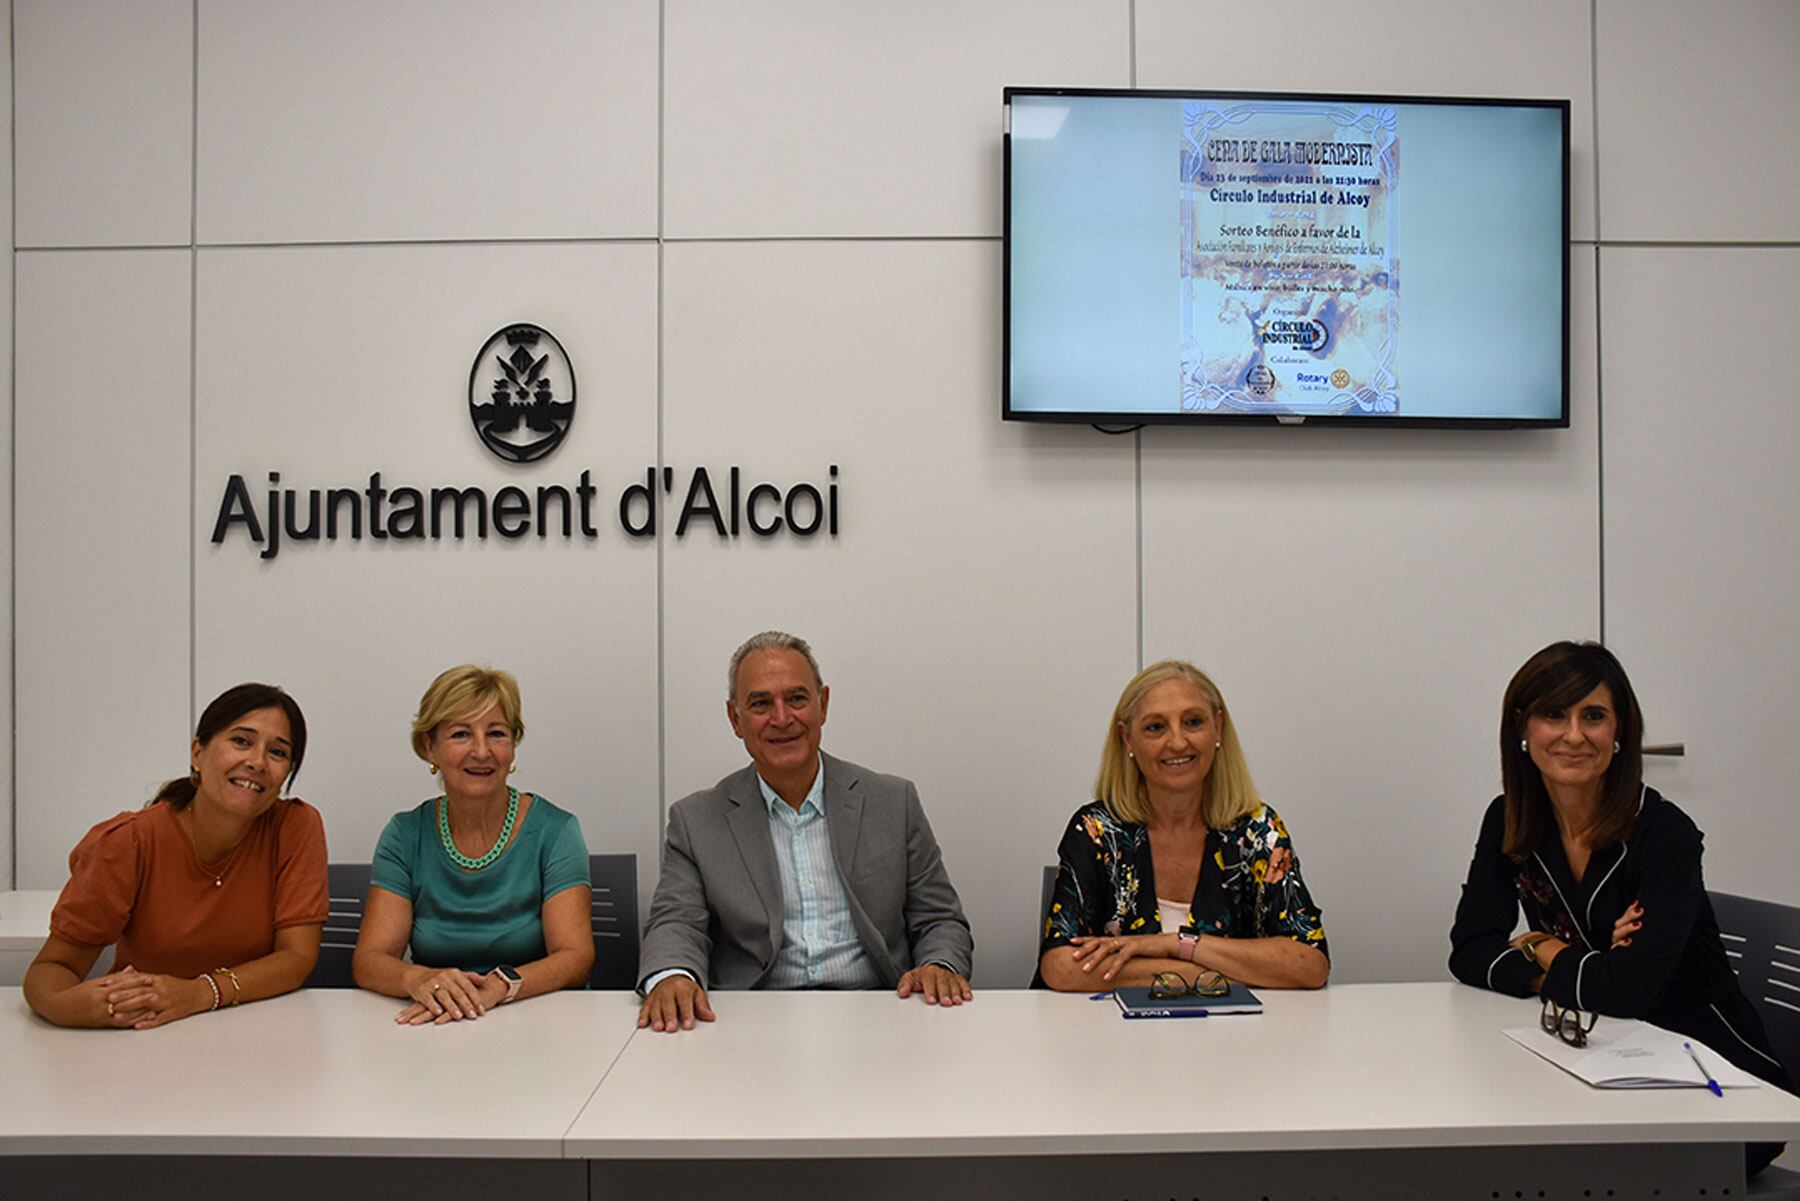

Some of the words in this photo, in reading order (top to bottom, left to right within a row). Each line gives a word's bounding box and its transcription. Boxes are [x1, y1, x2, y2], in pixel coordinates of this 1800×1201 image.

[1208, 140, 1239, 162] CENA
[1242, 140, 1258, 163] DE
[1261, 140, 1290, 164] GALA
[1295, 141, 1373, 166] MODERNISTA
[1228, 173, 1237, 182] de
[1239, 173, 1282, 184] septiembre
[1284, 174, 1293, 184] de
[1322, 175, 1333, 184] las
[1358, 176, 1380, 186] horas
[1258, 189, 1316, 205] Industrial
[1320, 190, 1334, 205] de
[1337, 191, 1371, 208] Alcoy
[1220, 224, 1253, 237] Sorteo
[1255, 224, 1299, 238] Benéfico
[1301, 229, 1307, 237] a
[1308, 224, 1334, 238] favor
[1336, 225, 1349, 238] de
[1351, 225, 1361, 239] la
[1272, 318, 1313, 333] CÍRCULO
[1262, 333, 1313, 344] INDUSTRIAL
[1297, 372, 1329, 384] Rotary
[211, 470, 598, 560] Ajuntament
[618, 464, 840, 540] d'Alcoi
